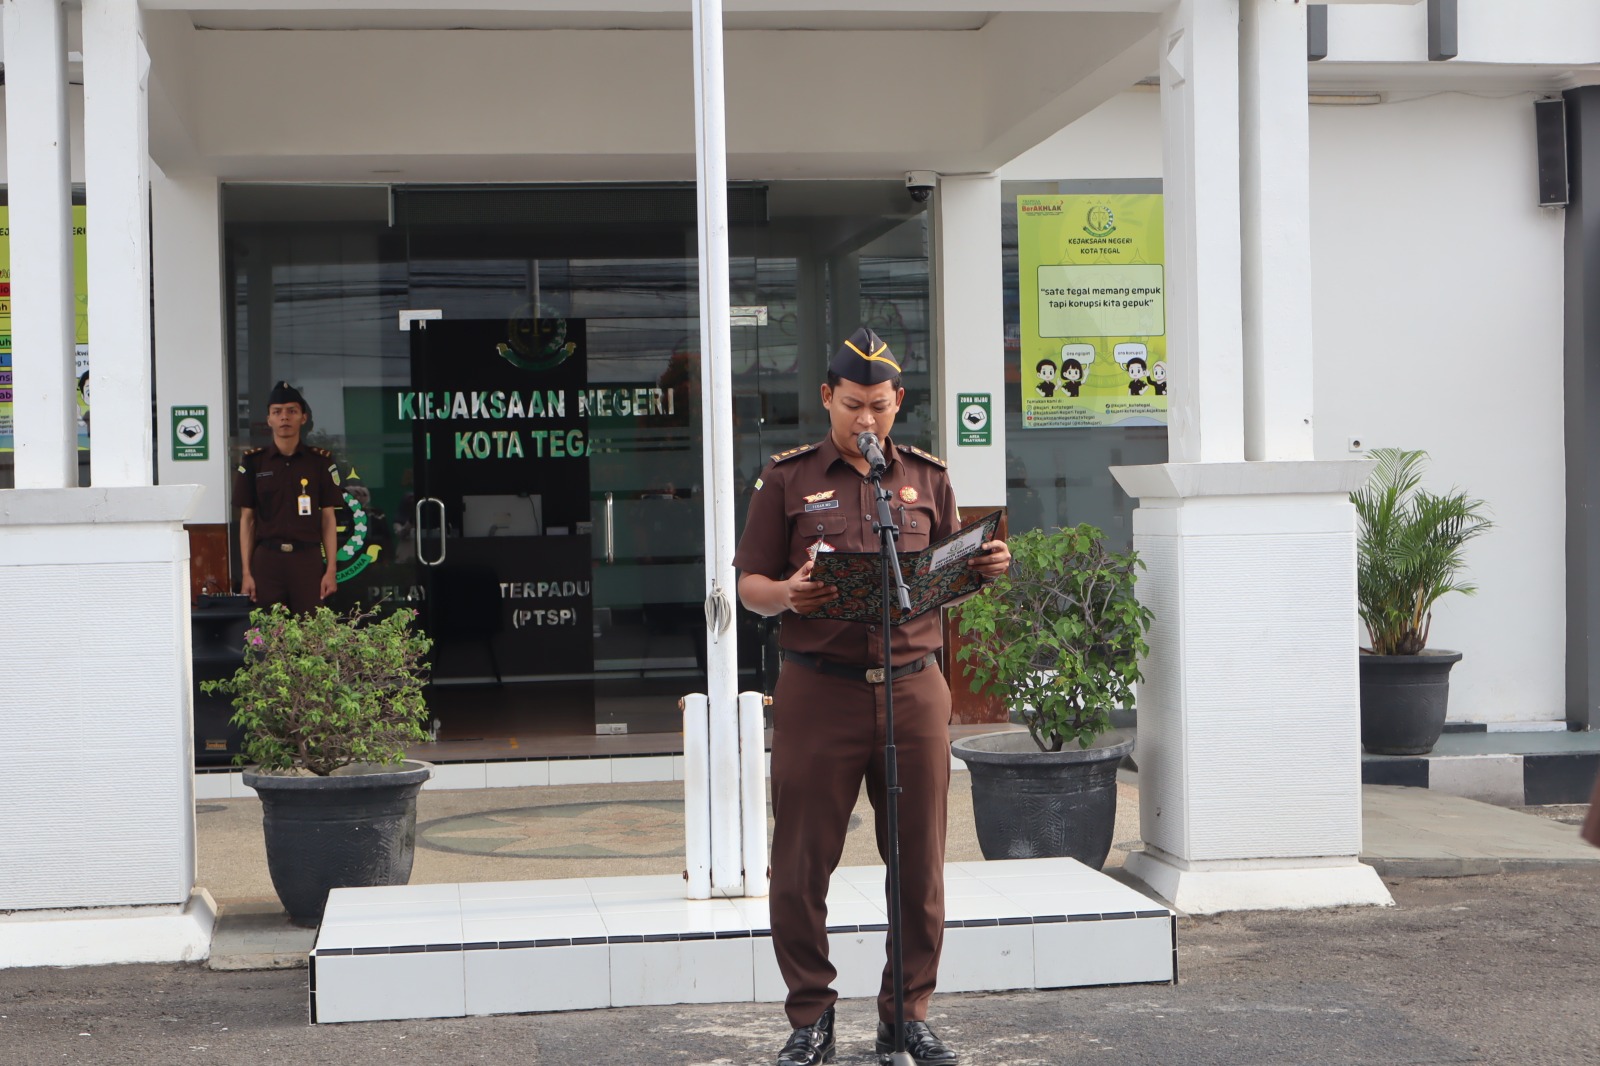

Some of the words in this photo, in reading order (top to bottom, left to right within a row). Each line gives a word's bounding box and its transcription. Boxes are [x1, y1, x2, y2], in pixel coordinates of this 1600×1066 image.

[1067, 287, 1091, 297] tegal
[1092, 288, 1129, 298] memang
[1131, 287, 1161, 298] empuk
[1049, 301, 1067, 309] tapi
[1068, 300, 1102, 309] korupsi
[577, 387, 675, 417] NEGERI
[454, 430, 525, 460] KOTA
[531, 429, 617, 458] TEG
[336, 557, 367, 580] CAKSANA
[499, 581, 590, 599] TERPADU
[512, 607, 577, 629] (PTSP)
